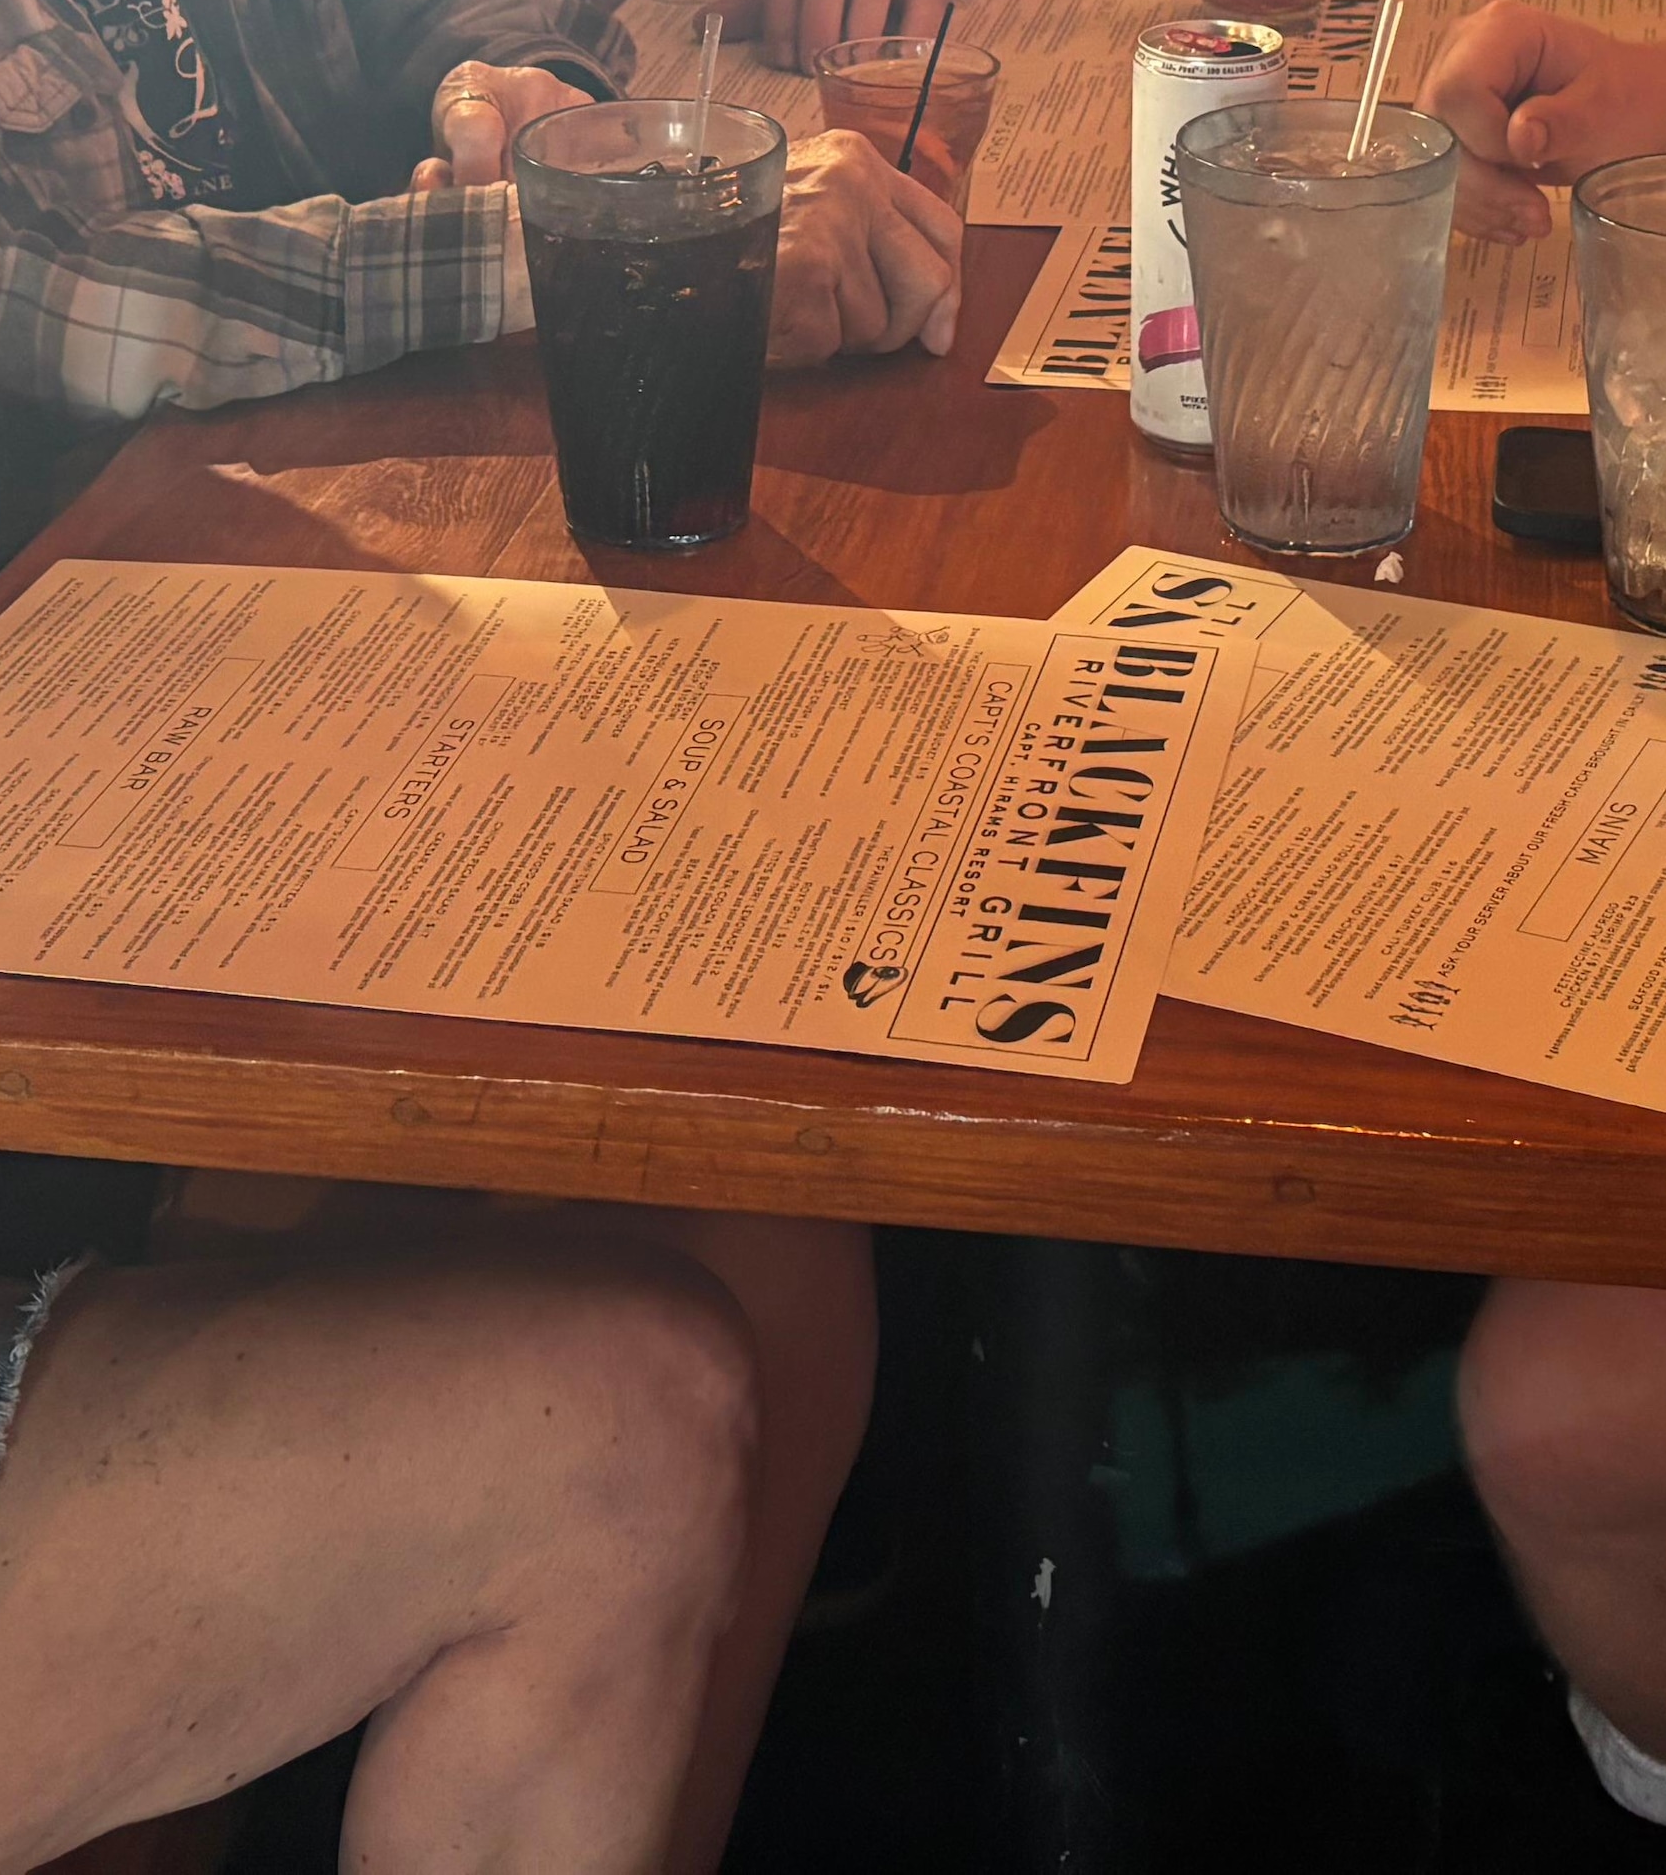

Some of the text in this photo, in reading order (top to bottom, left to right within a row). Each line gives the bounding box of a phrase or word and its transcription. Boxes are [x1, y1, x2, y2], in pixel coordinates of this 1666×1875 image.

[1160, 143, 1183, 207] WH
[1199, 600, 1256, 637] ILL
[118, 706, 213, 790] RAW BAR
[381, 718, 476, 819] STARTERS
[617, 718, 726, 864] SOUP & SALAD
[866, 680, 1015, 962] CAPT'S COASTAL CLASSICS
[876, 845, 894, 862] THE
[938, 659, 1104, 1012] RIVERFRONT GRILL
[947, 722, 1041, 917] CAPT. HIRAMS RESORT
[971, 645, 1198, 1048] BLACKFINS
[1435, 952, 1463, 977] ASK
[1451, 926, 1482, 955] YOUR
[1472, 882, 1513, 925] SERVER
[1500, 852, 1534, 885] ABOUT
[1525, 830, 1550, 851] OUR
[1540, 798, 1571, 829] FRESH
[1562, 769, 1593, 798] CATCH
[1584, 728, 1622, 768] BROUGHT
[1613, 717, 1630, 727] IN
[1574, 801, 1640, 865] MAINS
[850, 864, 885, 917] PAINKILLER
[1627, 968, 1661, 1011] SEAFOOD
